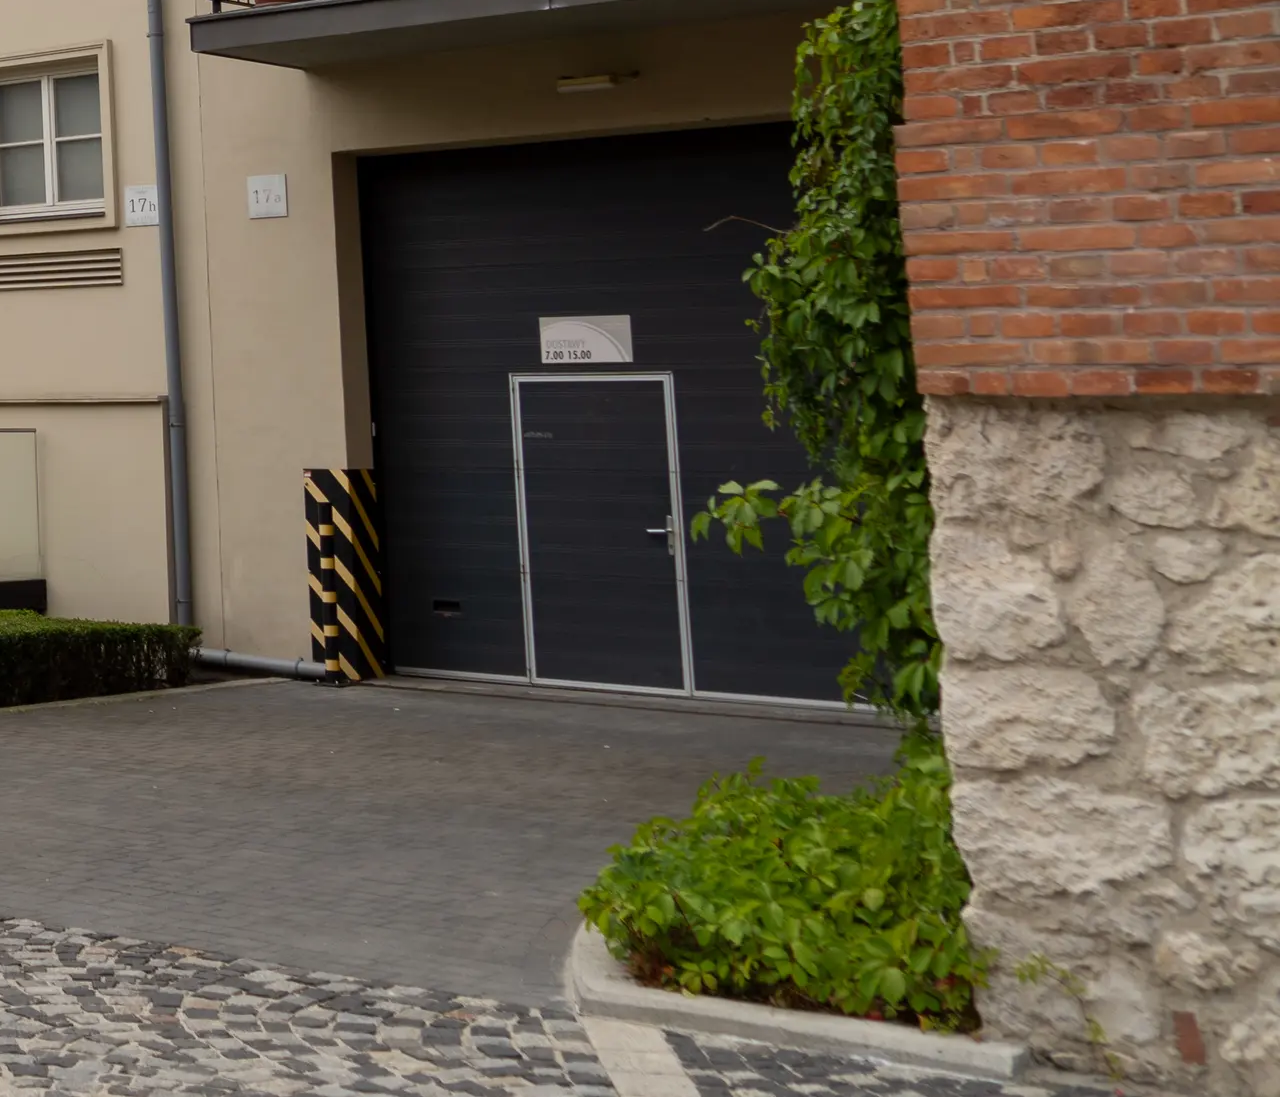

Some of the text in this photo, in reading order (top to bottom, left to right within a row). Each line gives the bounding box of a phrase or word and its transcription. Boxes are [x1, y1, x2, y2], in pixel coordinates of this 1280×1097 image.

[129, 198, 157, 213] 17h
[545, 350, 592, 360] 7.00 15.00
